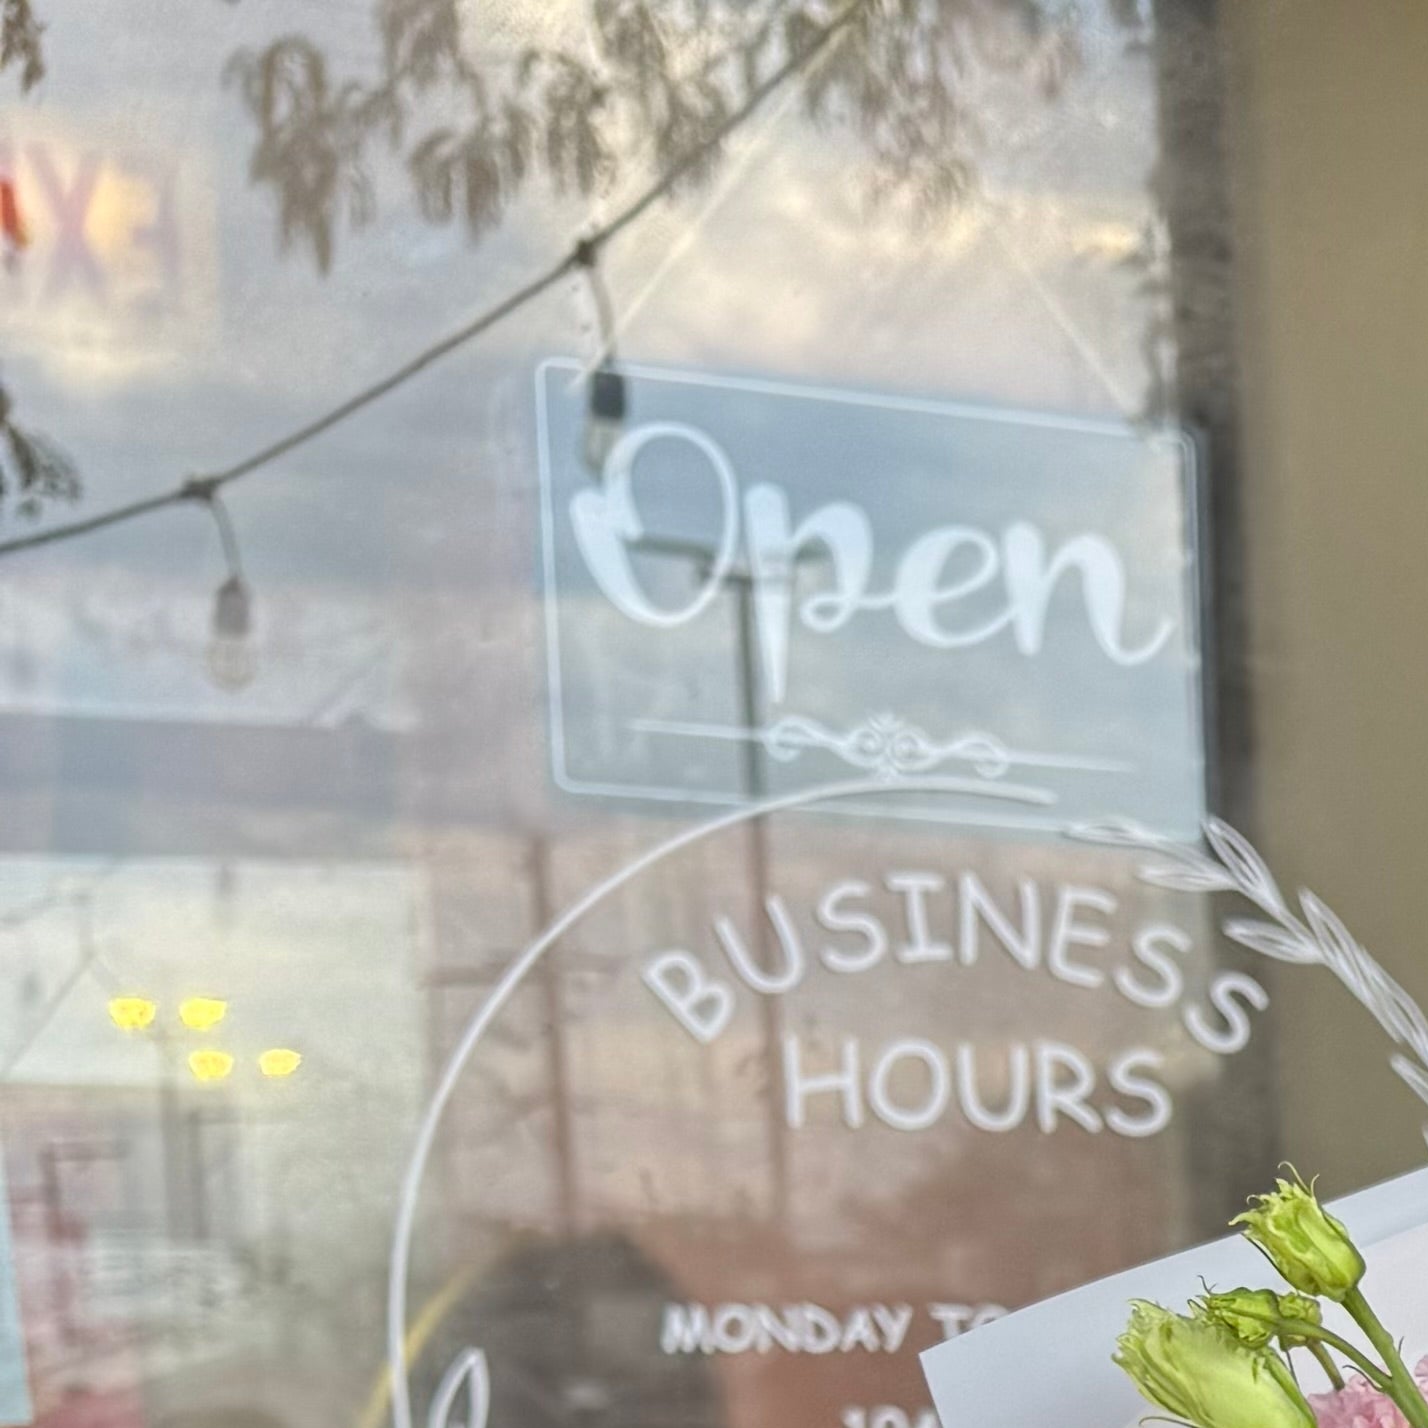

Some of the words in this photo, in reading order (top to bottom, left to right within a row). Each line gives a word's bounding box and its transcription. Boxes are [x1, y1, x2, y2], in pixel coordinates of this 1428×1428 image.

[571, 423, 1176, 703] Open
[642, 871, 1268, 1054] BUSINESS
[784, 1035, 1173, 1136] HOURS
[661, 1302, 912, 1354] MONDAY
